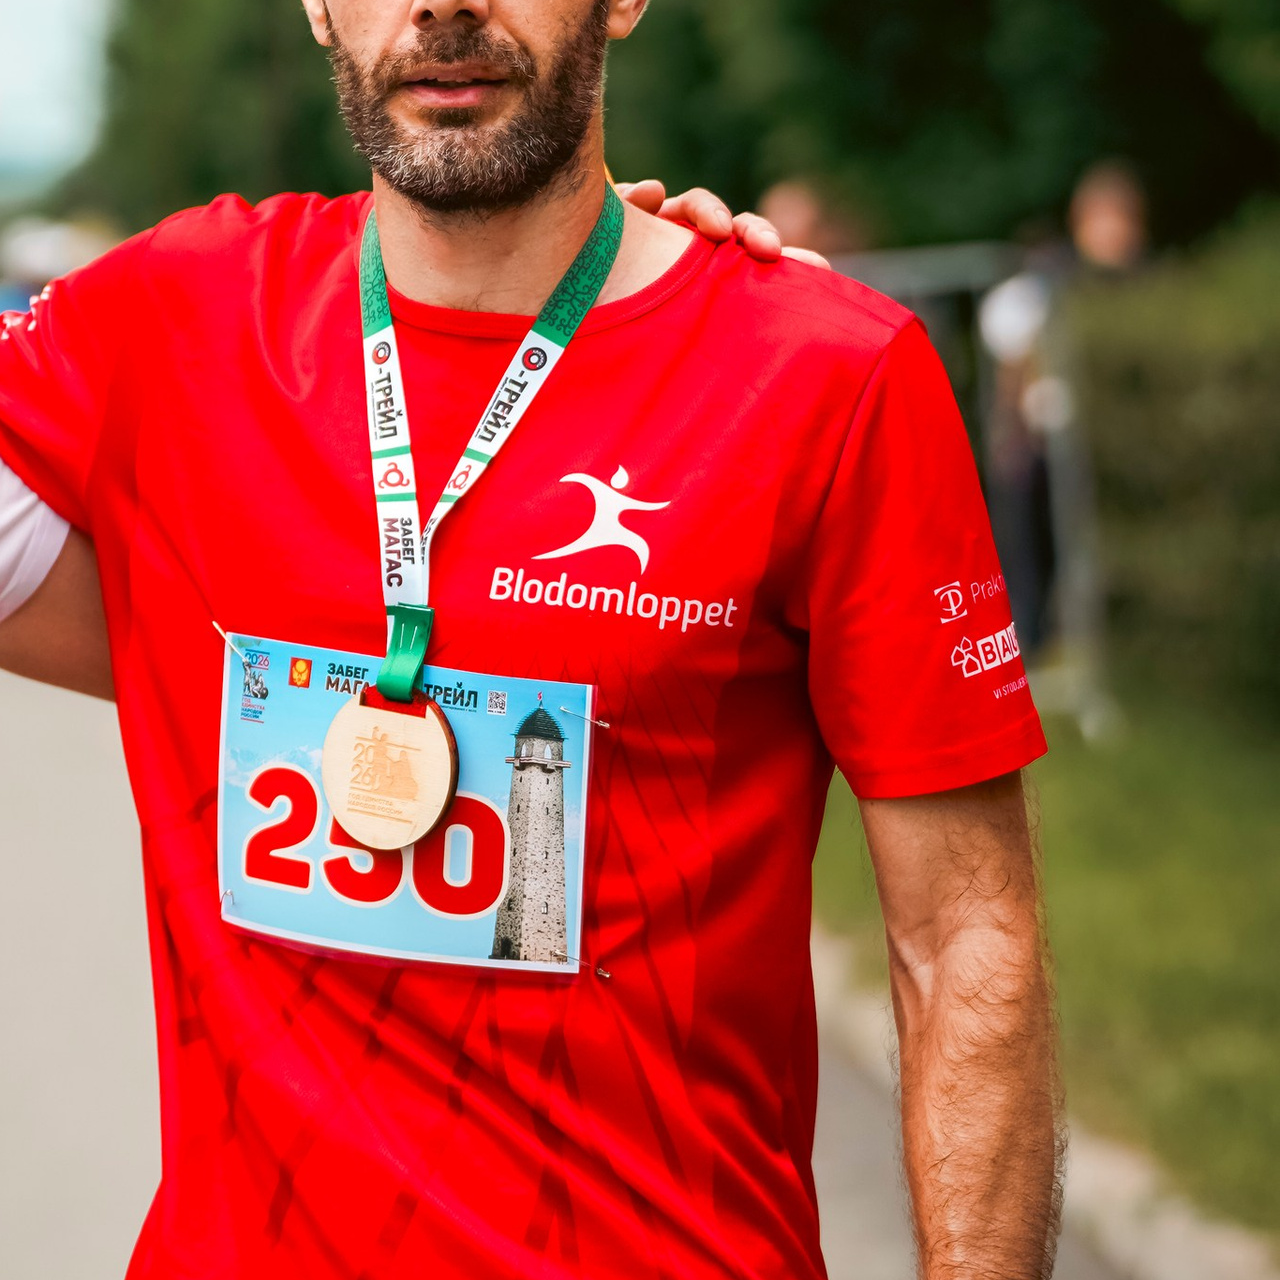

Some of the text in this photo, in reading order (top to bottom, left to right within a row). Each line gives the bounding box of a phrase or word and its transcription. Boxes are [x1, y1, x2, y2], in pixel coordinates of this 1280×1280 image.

[383, 518, 402, 588] МАГАС
[400, 517, 415, 565] ЗАБЕГ
[489, 567, 738, 632] Blodomloppet
[326, 675, 370, 695] МАГ
[327, 662, 369, 680] ЗАБЕГ
